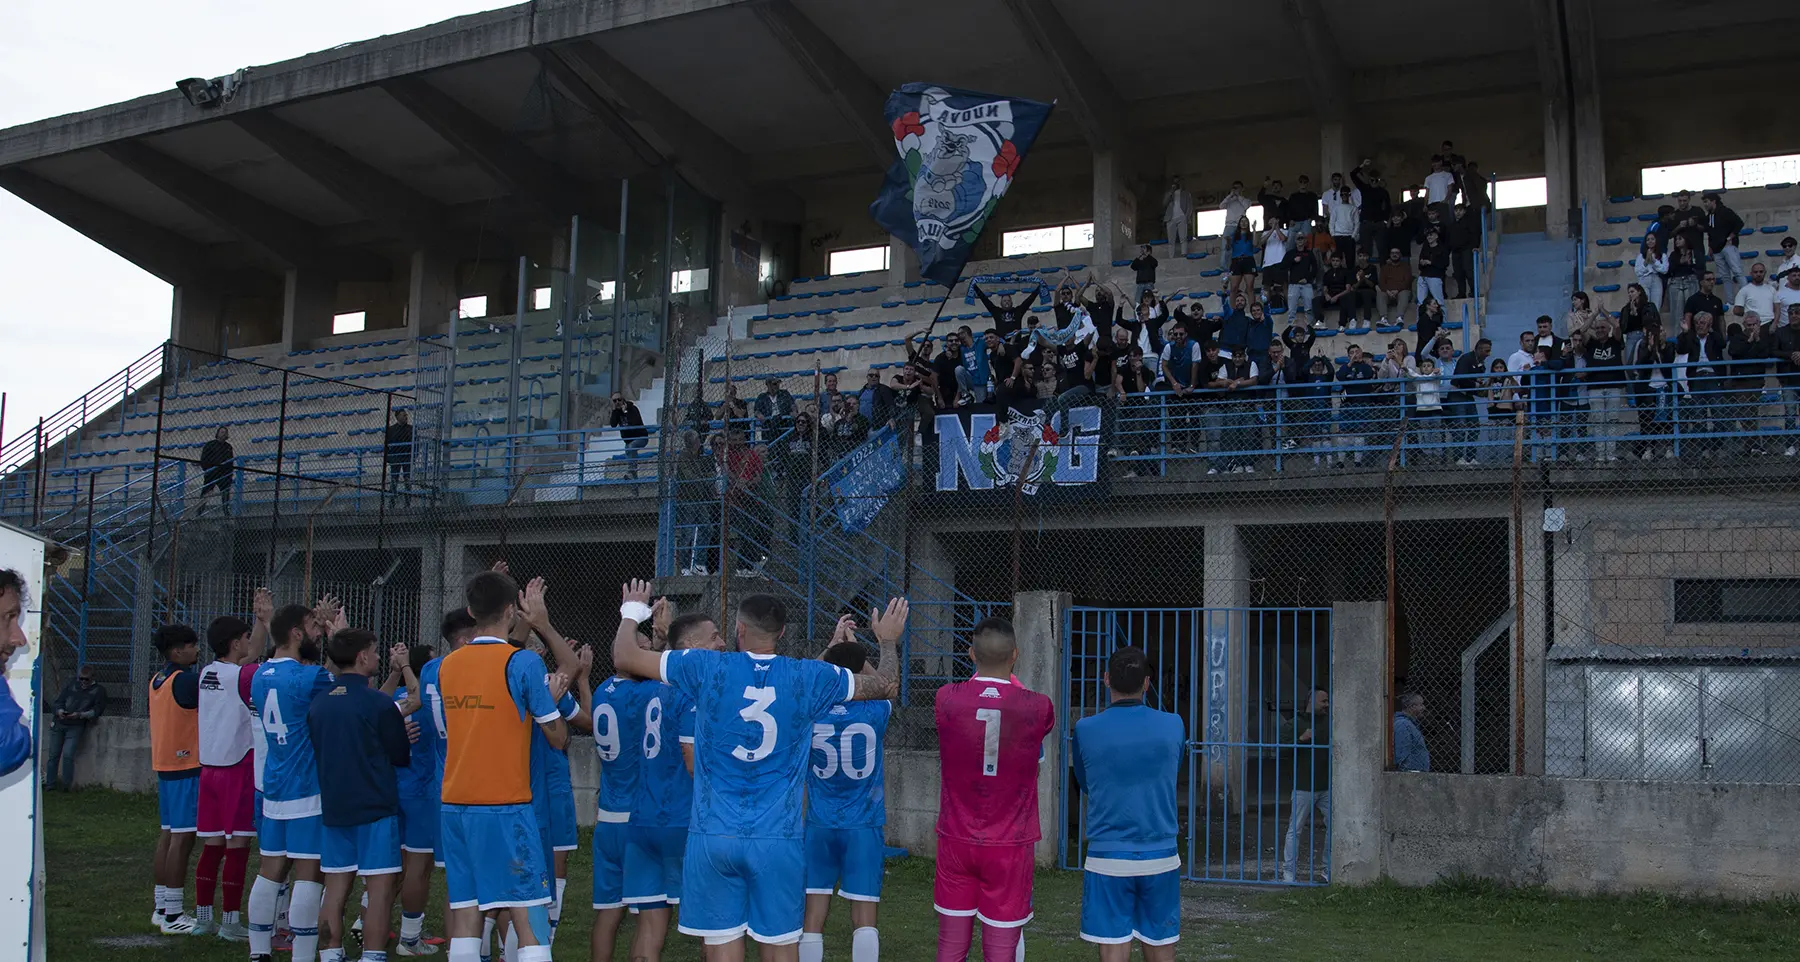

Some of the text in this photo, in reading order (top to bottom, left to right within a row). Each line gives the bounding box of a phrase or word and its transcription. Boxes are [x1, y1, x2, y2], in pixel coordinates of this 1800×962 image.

[1008, 409, 1038, 426] ULTRAS
[851, 443, 875, 468] 1922
[934, 405, 1102, 492] N G
[262, 688, 288, 745] 4
[445, 694, 495, 710] EVOL
[642, 697, 663, 760] 8
[731, 685, 778, 763] 3
[592, 703, 621, 762] 9
[811, 722, 877, 780] 30
[975, 708, 1001, 777] 1
